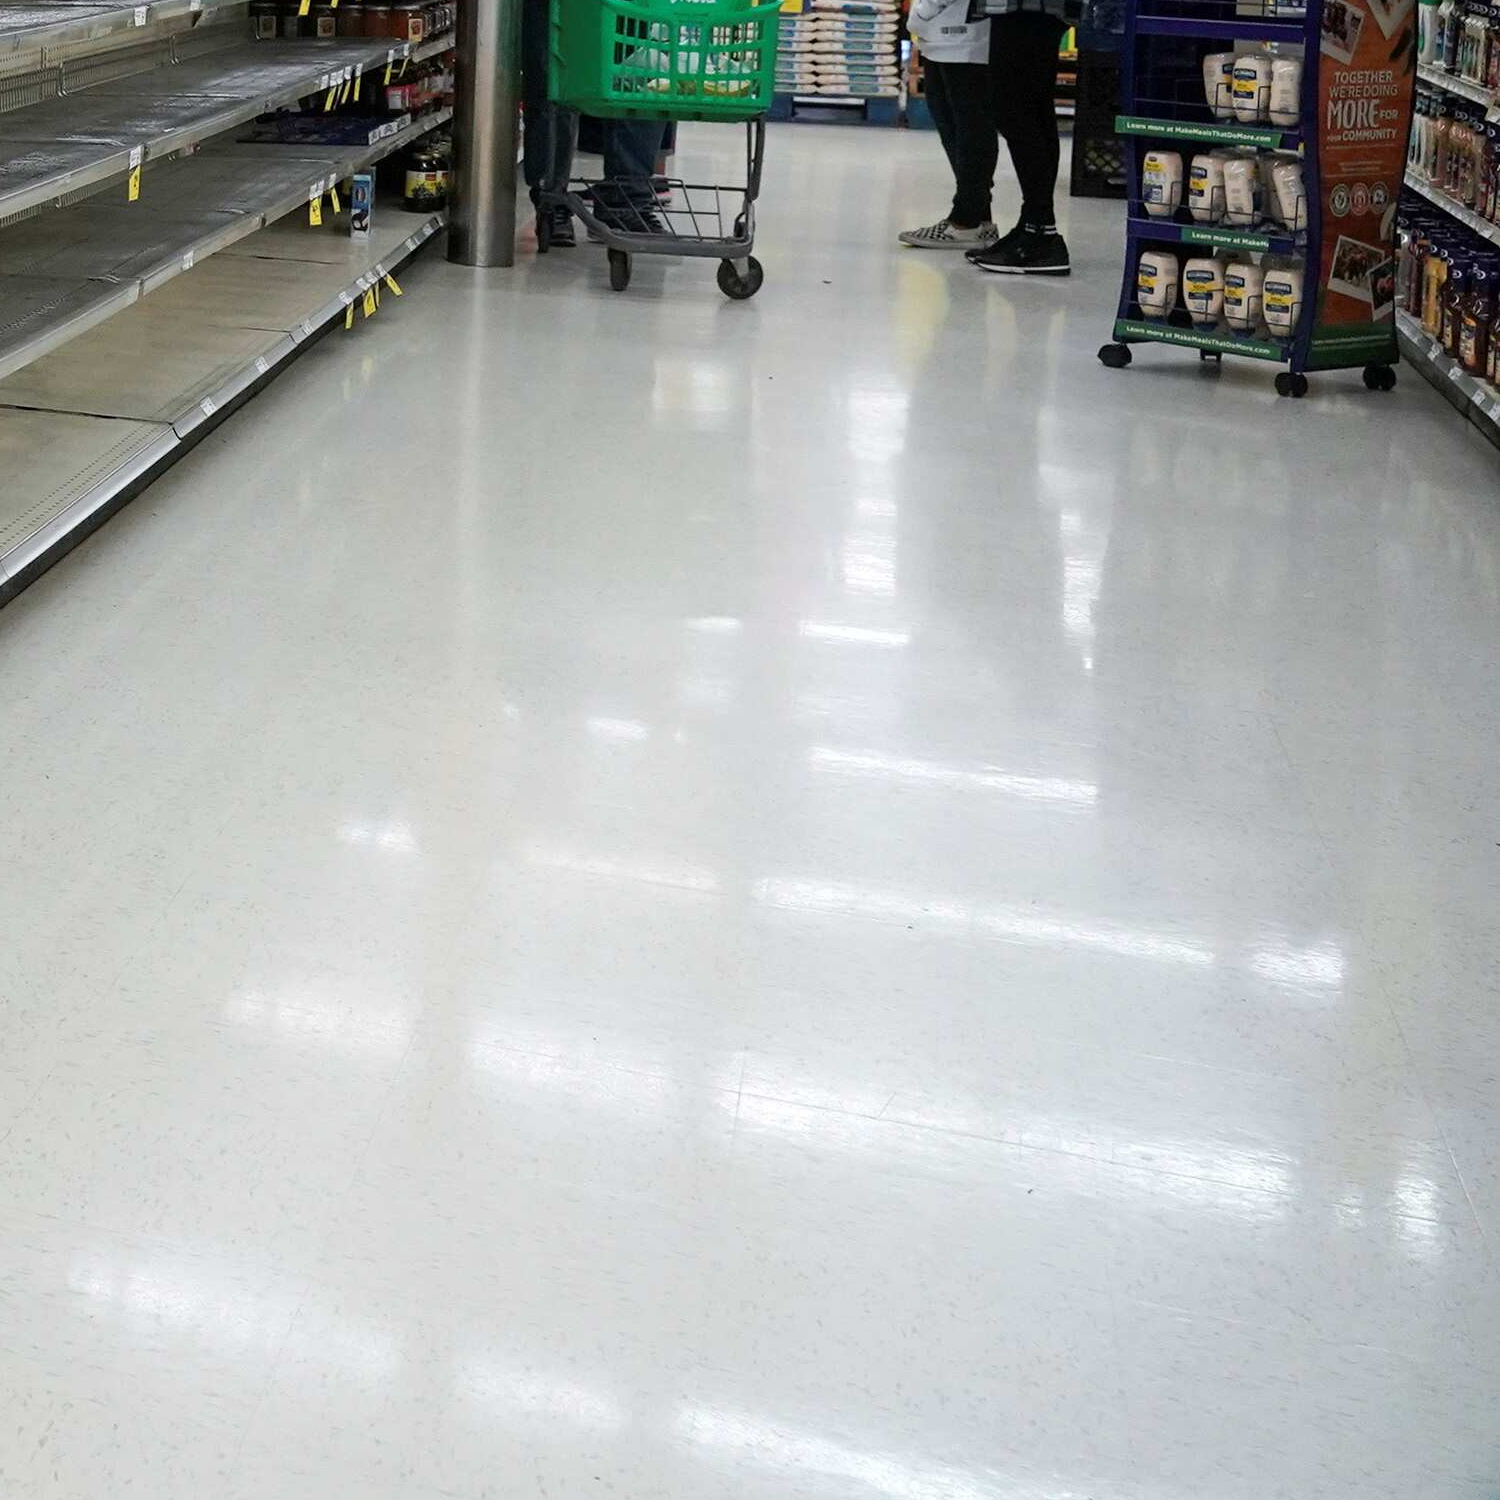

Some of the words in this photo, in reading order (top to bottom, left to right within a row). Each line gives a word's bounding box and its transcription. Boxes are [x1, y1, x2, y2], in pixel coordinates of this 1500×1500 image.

[1334, 71, 1393, 85] TOGETHER
[1363, 85, 1398, 97] DOING
[1327, 99, 1380, 130] MORE
[1380, 109, 1398, 120] FOR
[1127, 122, 1147, 130] Learn
[1148, 124, 1165, 132] more
[1342, 128, 1398, 141] COMMUNITY
[1192, 231, 1212, 240] Learn
[1126, 326, 1145, 334] Learn
